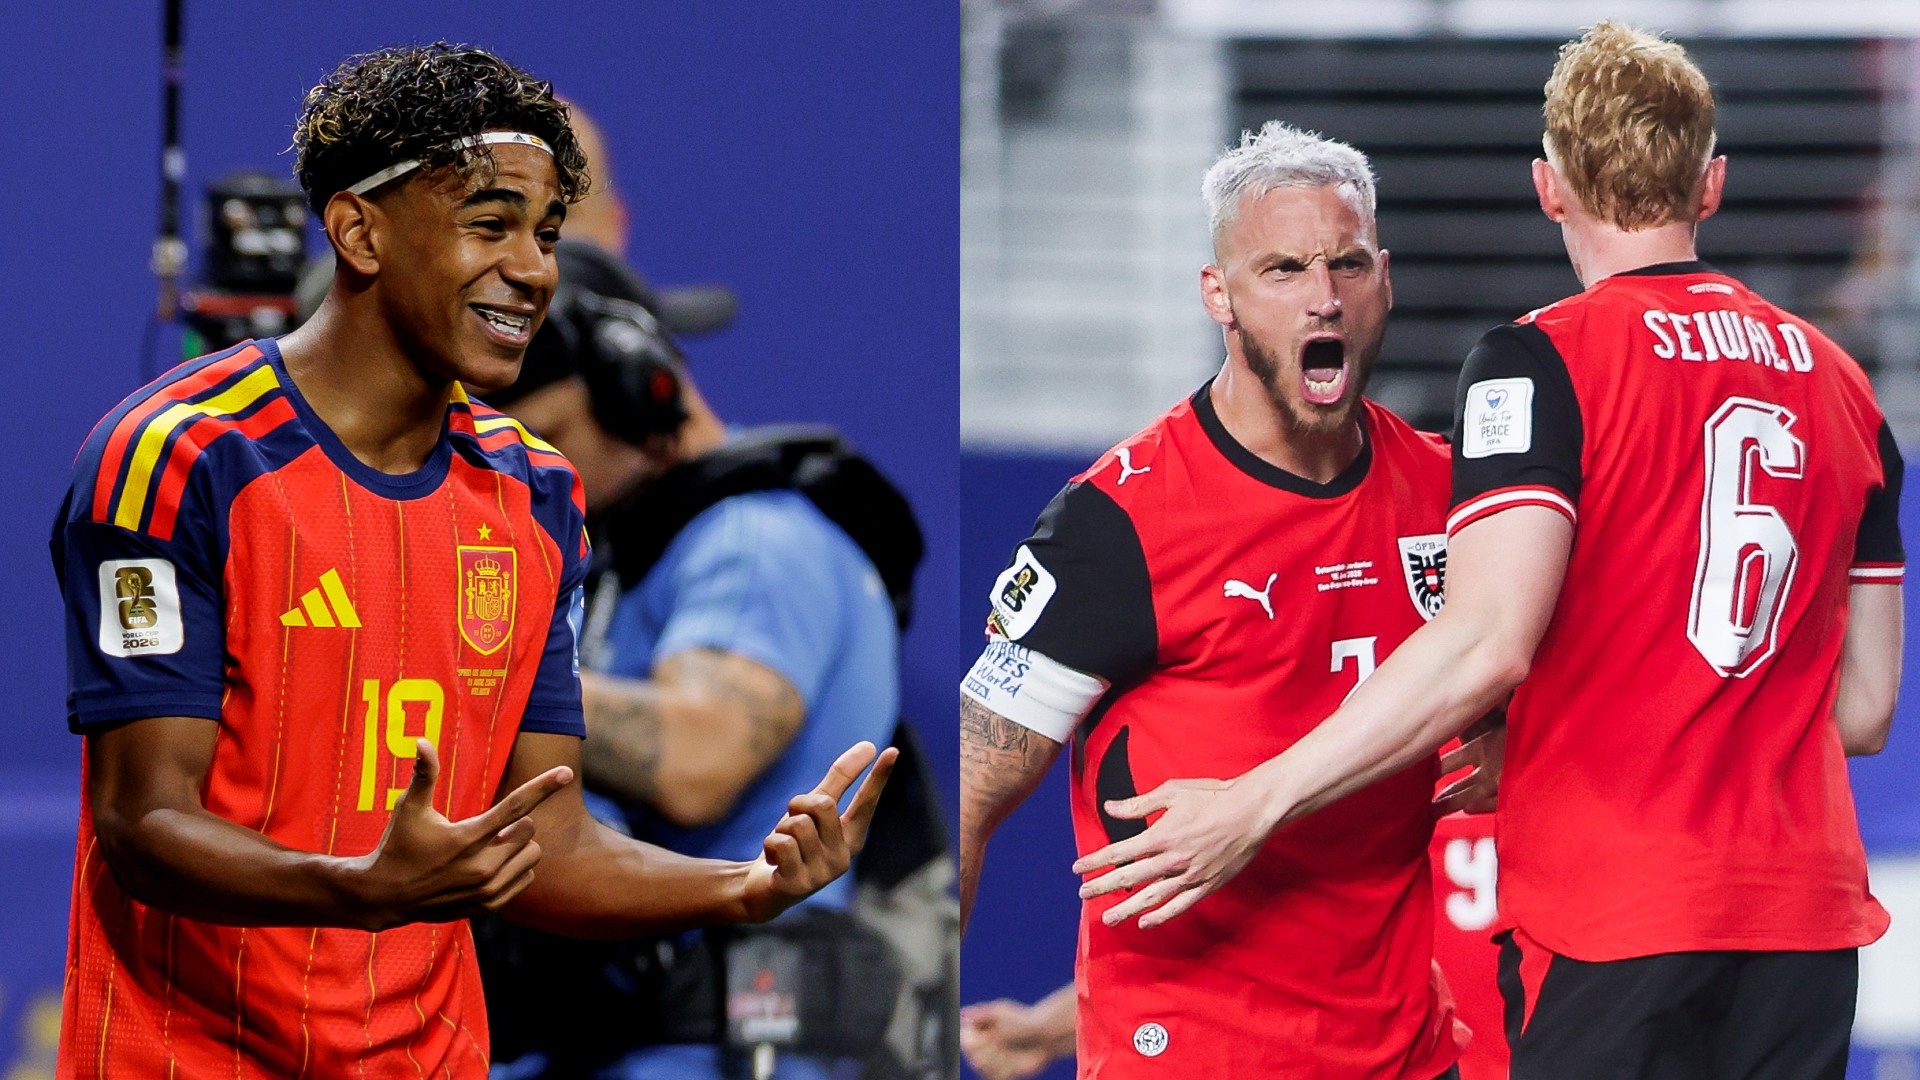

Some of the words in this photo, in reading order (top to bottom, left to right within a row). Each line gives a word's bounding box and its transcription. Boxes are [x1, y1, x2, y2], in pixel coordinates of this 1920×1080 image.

[1643, 308, 1815, 373] SEIWALD
[1481, 424, 1509, 438] PEACE
[1686, 395, 1805, 679] 6
[128, 616, 148, 625] FIFA
[122, 638, 160, 649] 2026
[976, 663, 1023, 698] World
[356, 678, 444, 812] 19
